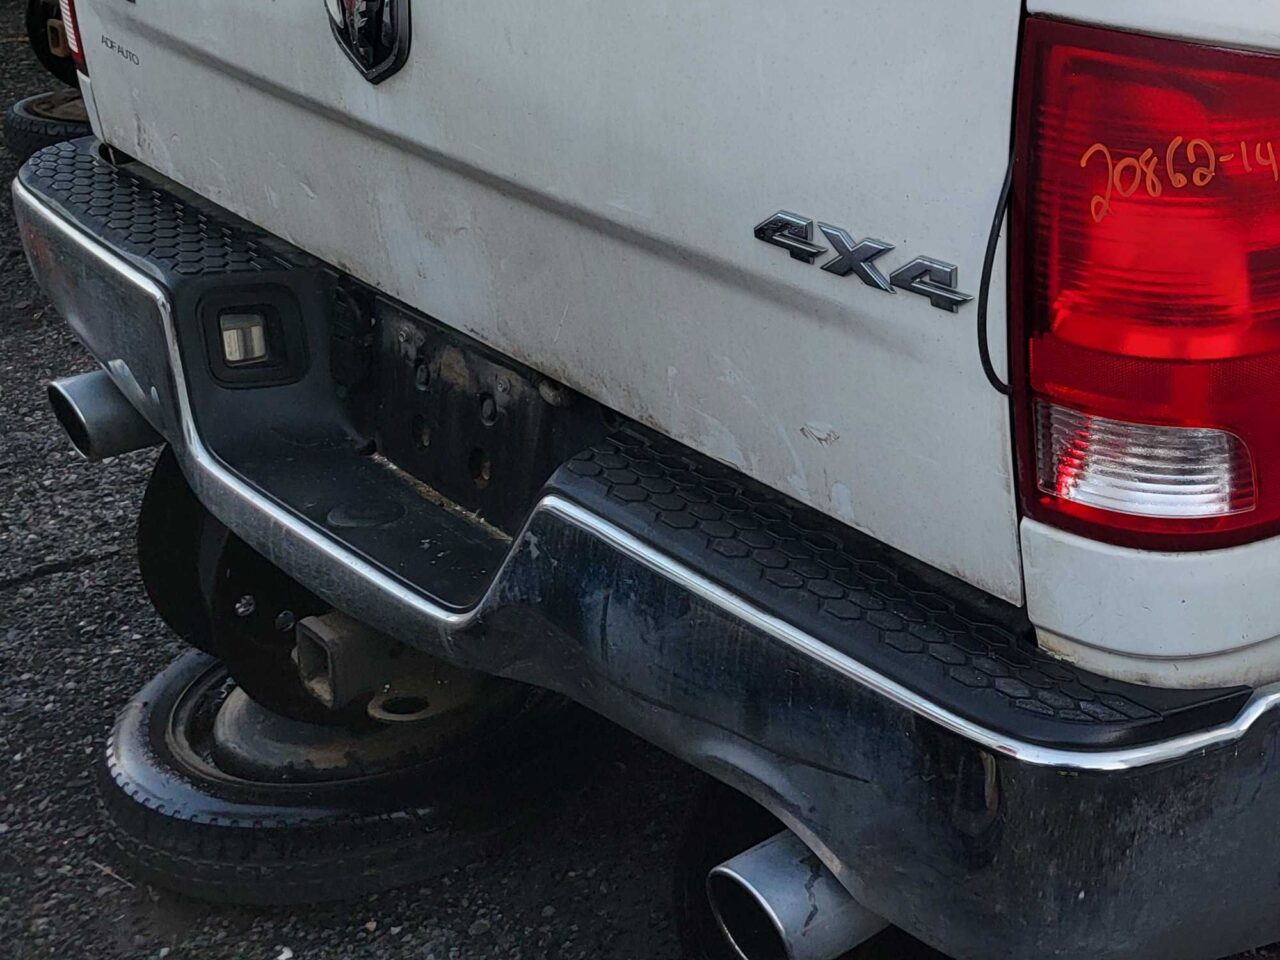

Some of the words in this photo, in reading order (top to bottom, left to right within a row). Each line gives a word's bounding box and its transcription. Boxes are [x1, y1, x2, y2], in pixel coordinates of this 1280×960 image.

[117, 44, 140, 66] AUTO
[1080, 136, 1279, 223] 20862-14
[754, 209, 975, 313] 4X4
